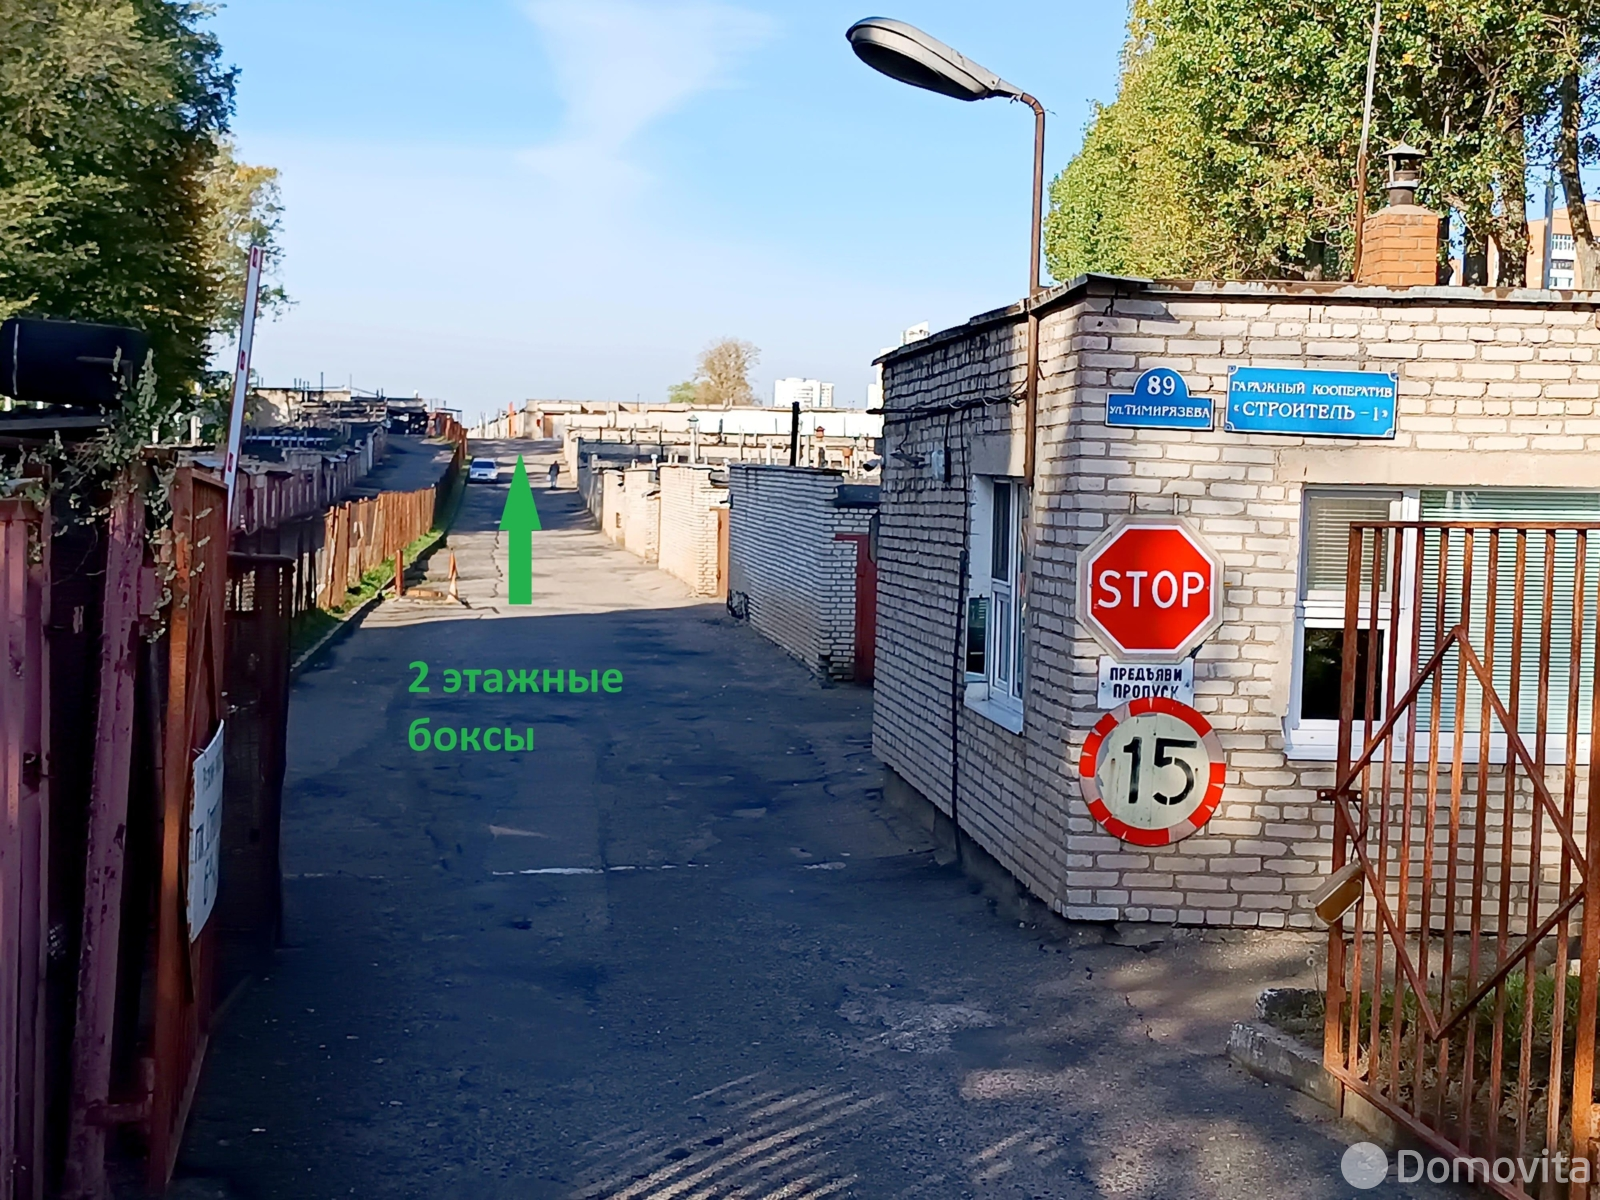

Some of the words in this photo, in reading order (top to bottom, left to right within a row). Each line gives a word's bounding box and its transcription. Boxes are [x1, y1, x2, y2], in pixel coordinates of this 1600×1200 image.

[1147, 375, 1175, 396] 89
[1231, 381, 1306, 394] ГАРАЖНЫЙ
[1312, 384, 1393, 398] КООПЕРАТИВ
[1124, 404, 1210, 418] ТИМИРЯЗЕВА
[1098, 570, 1205, 609] STOP
[1109, 667, 1183, 682] ПРЕДЪЯВИ
[1123, 736, 1198, 806] 15
